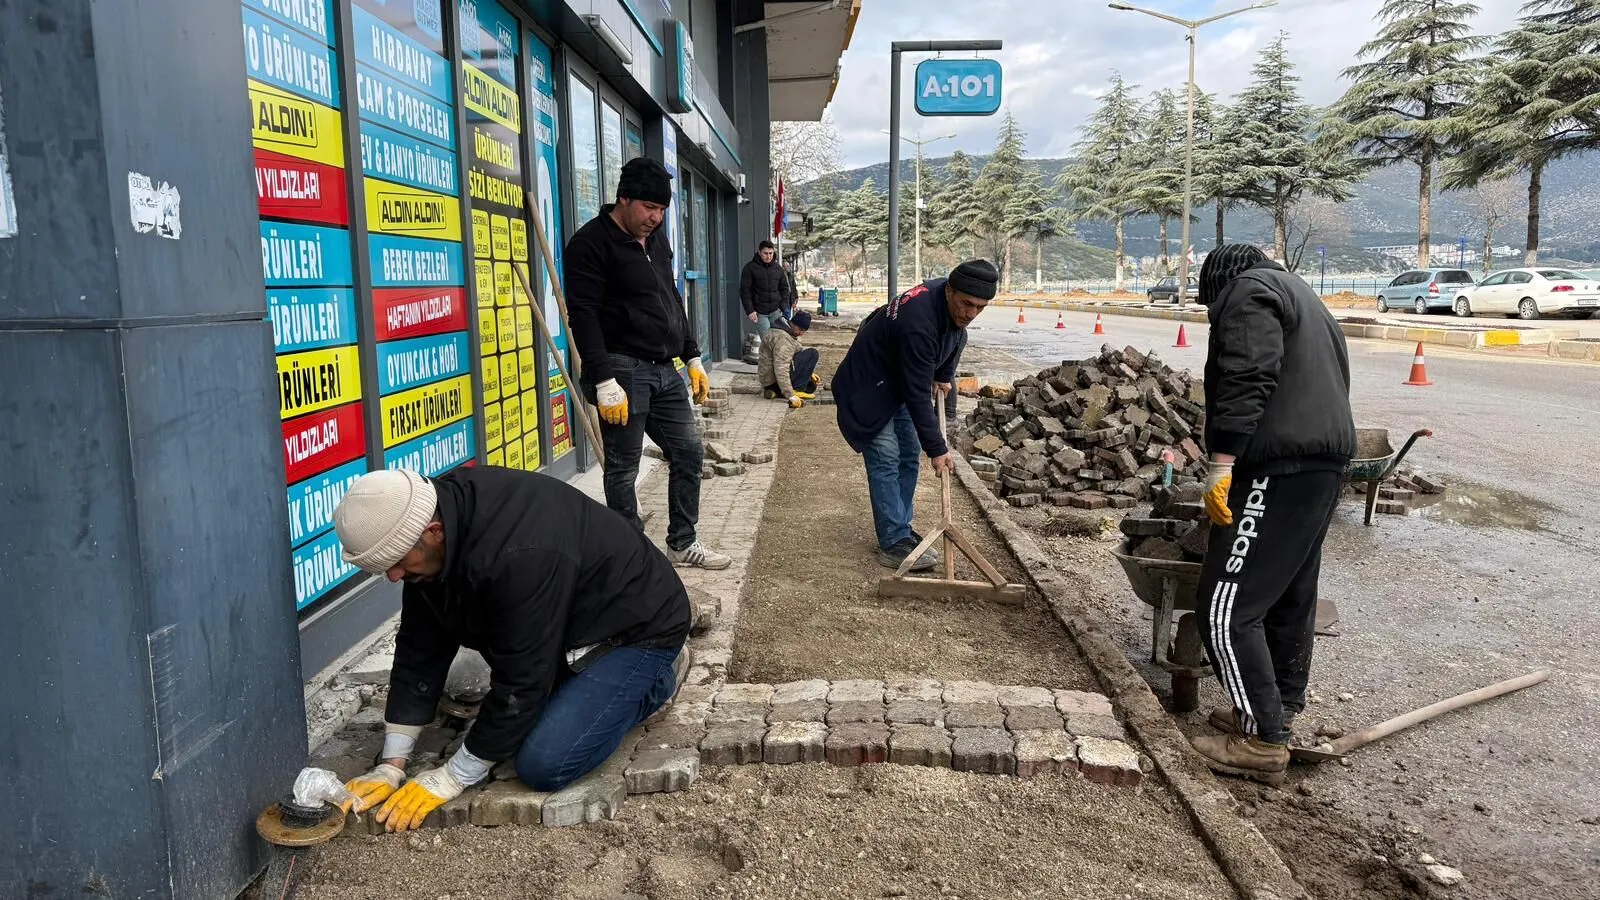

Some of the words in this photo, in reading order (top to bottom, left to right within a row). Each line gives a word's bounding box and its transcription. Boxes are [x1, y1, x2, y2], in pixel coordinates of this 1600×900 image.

[263, 24, 332, 100] ÜRÜNLERİ
[371, 24, 432, 87] HIRDAVAT
[356, 72, 384, 116] CAM
[386, 86, 396, 120] &
[397, 91, 449, 141] PORSELEN
[360, 133, 372, 170] EV
[375, 138, 383, 173] &
[383, 141, 414, 180] BANYO
[415, 145, 454, 190] ÜRÜNLERİ
[474, 126, 514, 170] ÜRÜNLERİ
[263, 168, 320, 199] YILDIZLARI
[468, 166, 486, 199] SİZİ
[486, 176, 523, 209] BEKLİYOR
[382, 200, 412, 223] ALDIN
[382, 248, 414, 281] BEBEK
[415, 246, 449, 281] BEZLERİ
[270, 294, 340, 347] ÜRÜNLERİ
[387, 302, 421, 331] HAFTANIN
[420, 295, 452, 322] YILDIZLARI
[387, 347, 431, 387] OYUNCAK
[432, 346, 438, 377] &
[438, 337, 458, 375] HOBİ
[389, 400, 421, 439] FIRSAT
[423, 381, 462, 427] ÜRÜNLERİ
[285, 418, 339, 466] YILDIZLARI
[422, 424, 468, 476] ÜRÜNLERİ
[1225, 476, 1270, 573] adidas
